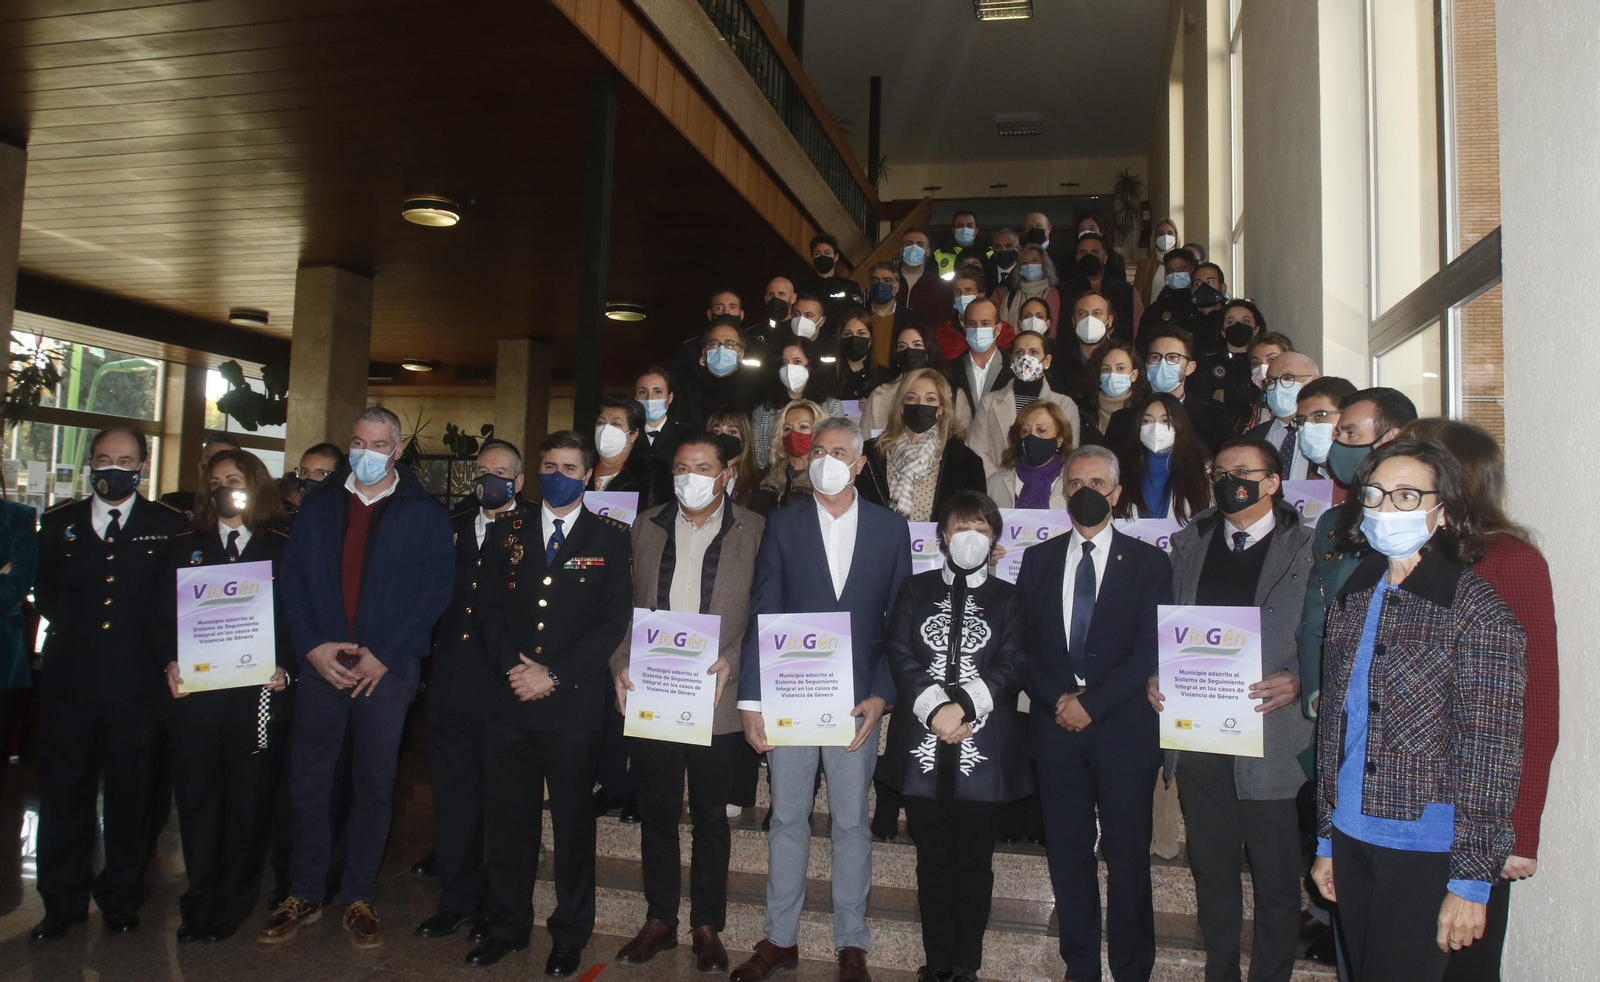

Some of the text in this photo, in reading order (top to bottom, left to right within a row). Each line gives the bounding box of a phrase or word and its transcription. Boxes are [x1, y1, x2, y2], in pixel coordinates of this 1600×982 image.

[1010, 526, 1066, 540] VioGé
[194, 580, 259, 599] VioGén
[647, 628, 707, 649] VioGén
[774, 633, 838, 650] VioGén
[1175, 627, 1245, 646] VioGén
